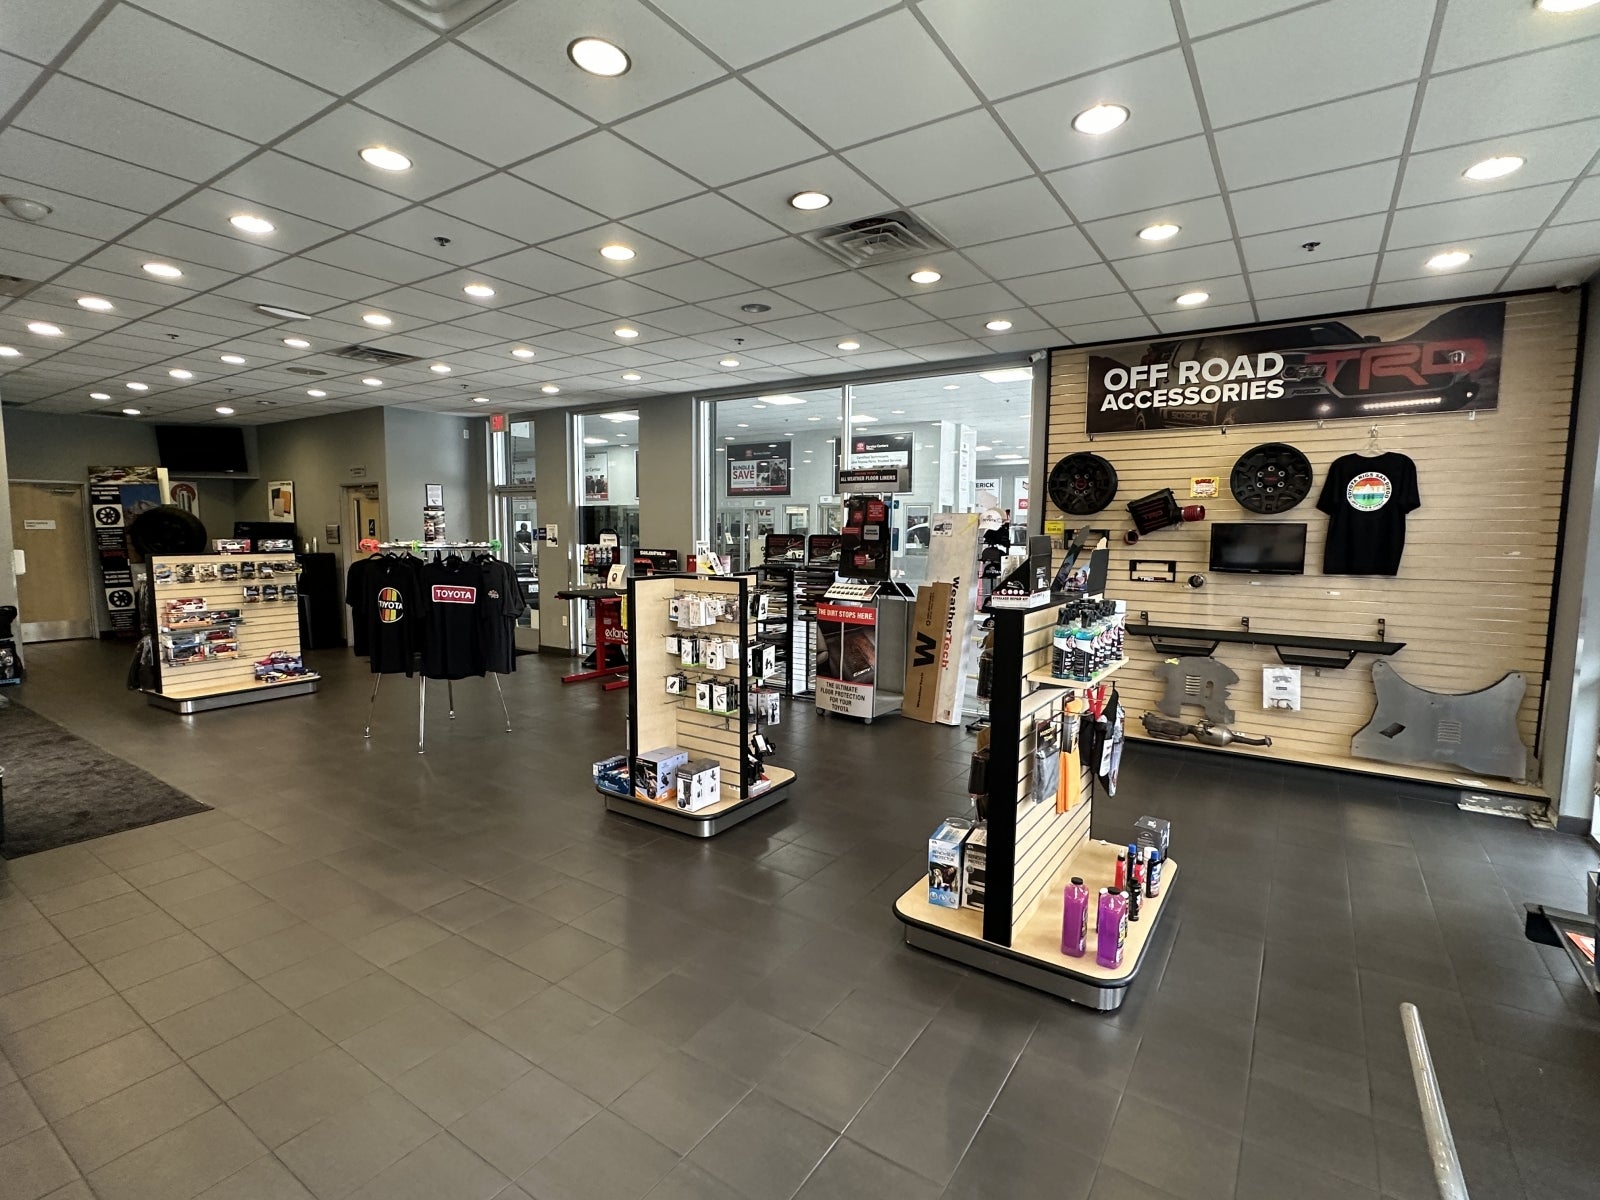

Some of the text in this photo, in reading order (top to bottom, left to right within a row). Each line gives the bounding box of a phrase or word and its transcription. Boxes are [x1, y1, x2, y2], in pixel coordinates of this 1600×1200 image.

[1304, 338, 1488, 390] TRD
[1103, 352, 1284, 391] OFF ROAD
[1100, 379, 1285, 412] ACCESSORIES
[732, 470, 755, 480] SAVE
[435, 590, 472, 599] TOYOTA
[378, 600, 403, 610] TOYOTA
[818, 608, 874, 620] THE DIRT STOPS HERE.
[941, 576, 960, 668] WeatherTech
[826, 681, 858, 693] THE ULTIMATE
[820, 688, 866, 701] FLOOR PROTECTION
[829, 696, 852, 706] FOR YOUR
[831, 703, 849, 712] TOYOTA
